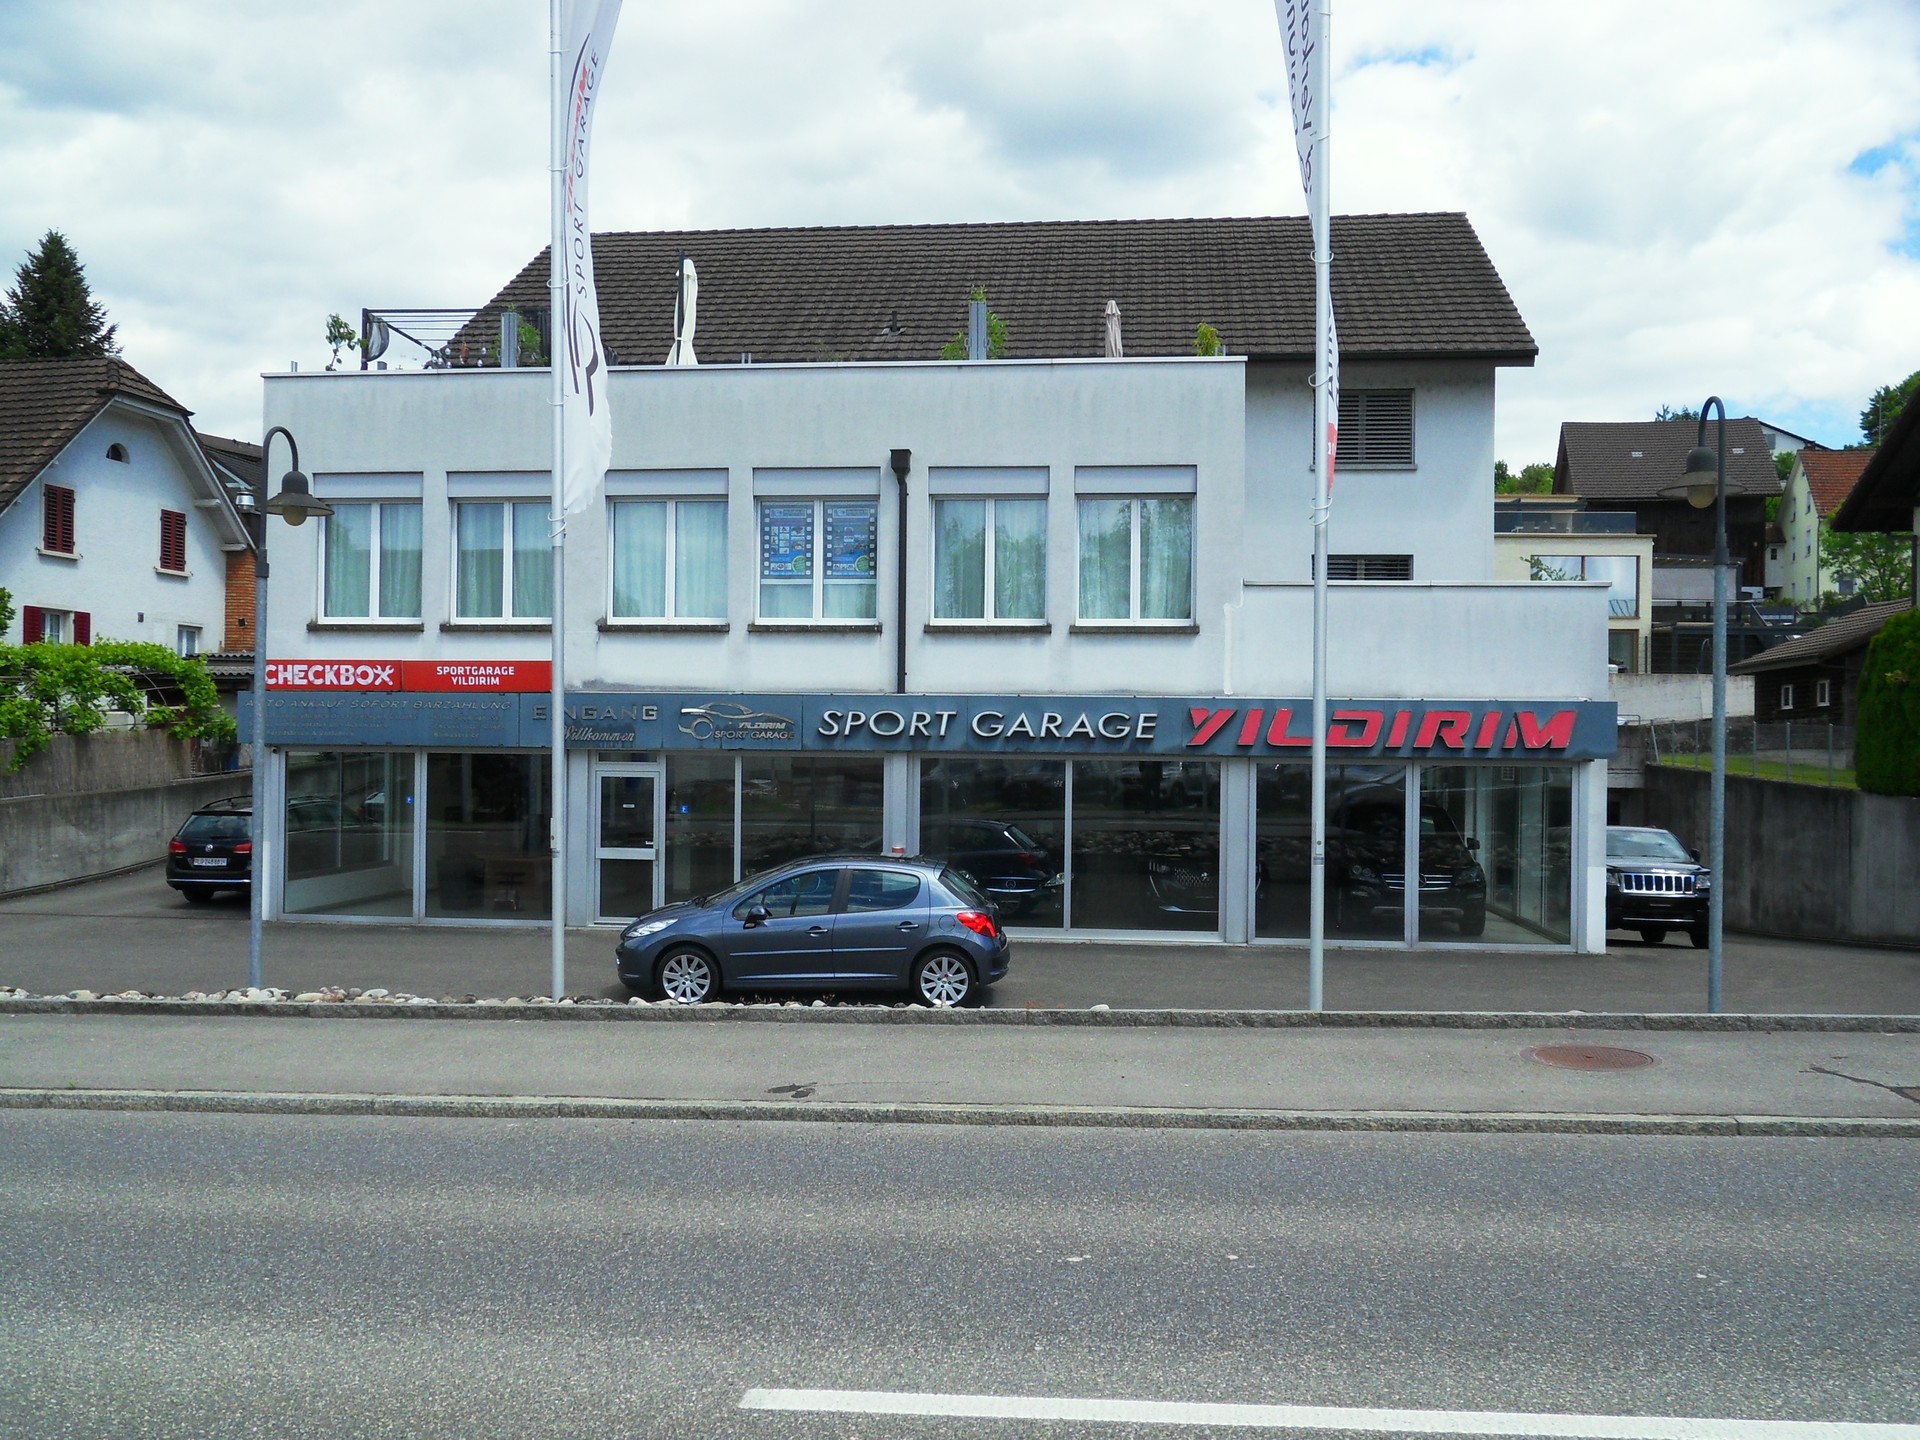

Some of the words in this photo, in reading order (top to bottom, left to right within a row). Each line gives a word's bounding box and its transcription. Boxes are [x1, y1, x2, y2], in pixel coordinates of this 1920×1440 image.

[575, 48, 599, 179] GARAGE
[574, 197, 588, 301] SPORT
[265, 664, 395, 686] CHECKBOX
[436, 665, 515, 676] SPORTGARAGE
[451, 676, 500, 686] YILDIRIM
[245, 699, 285, 708] ATO
[290, 699, 345, 709] ANKAUF
[350, 700, 408, 709] SOFORT
[413, 701, 512, 711] BARZAHLUNG
[532, 704, 659, 721] ENGANG
[738, 721, 787, 730] YILDIRIM
[817, 709, 958, 738] SPORT
[970, 710, 1160, 740] GARAGE
[1186, 706, 1579, 749] YILDIRIM
[714, 730, 749, 739] SPORT
[750, 730, 796, 740] GARAGE
